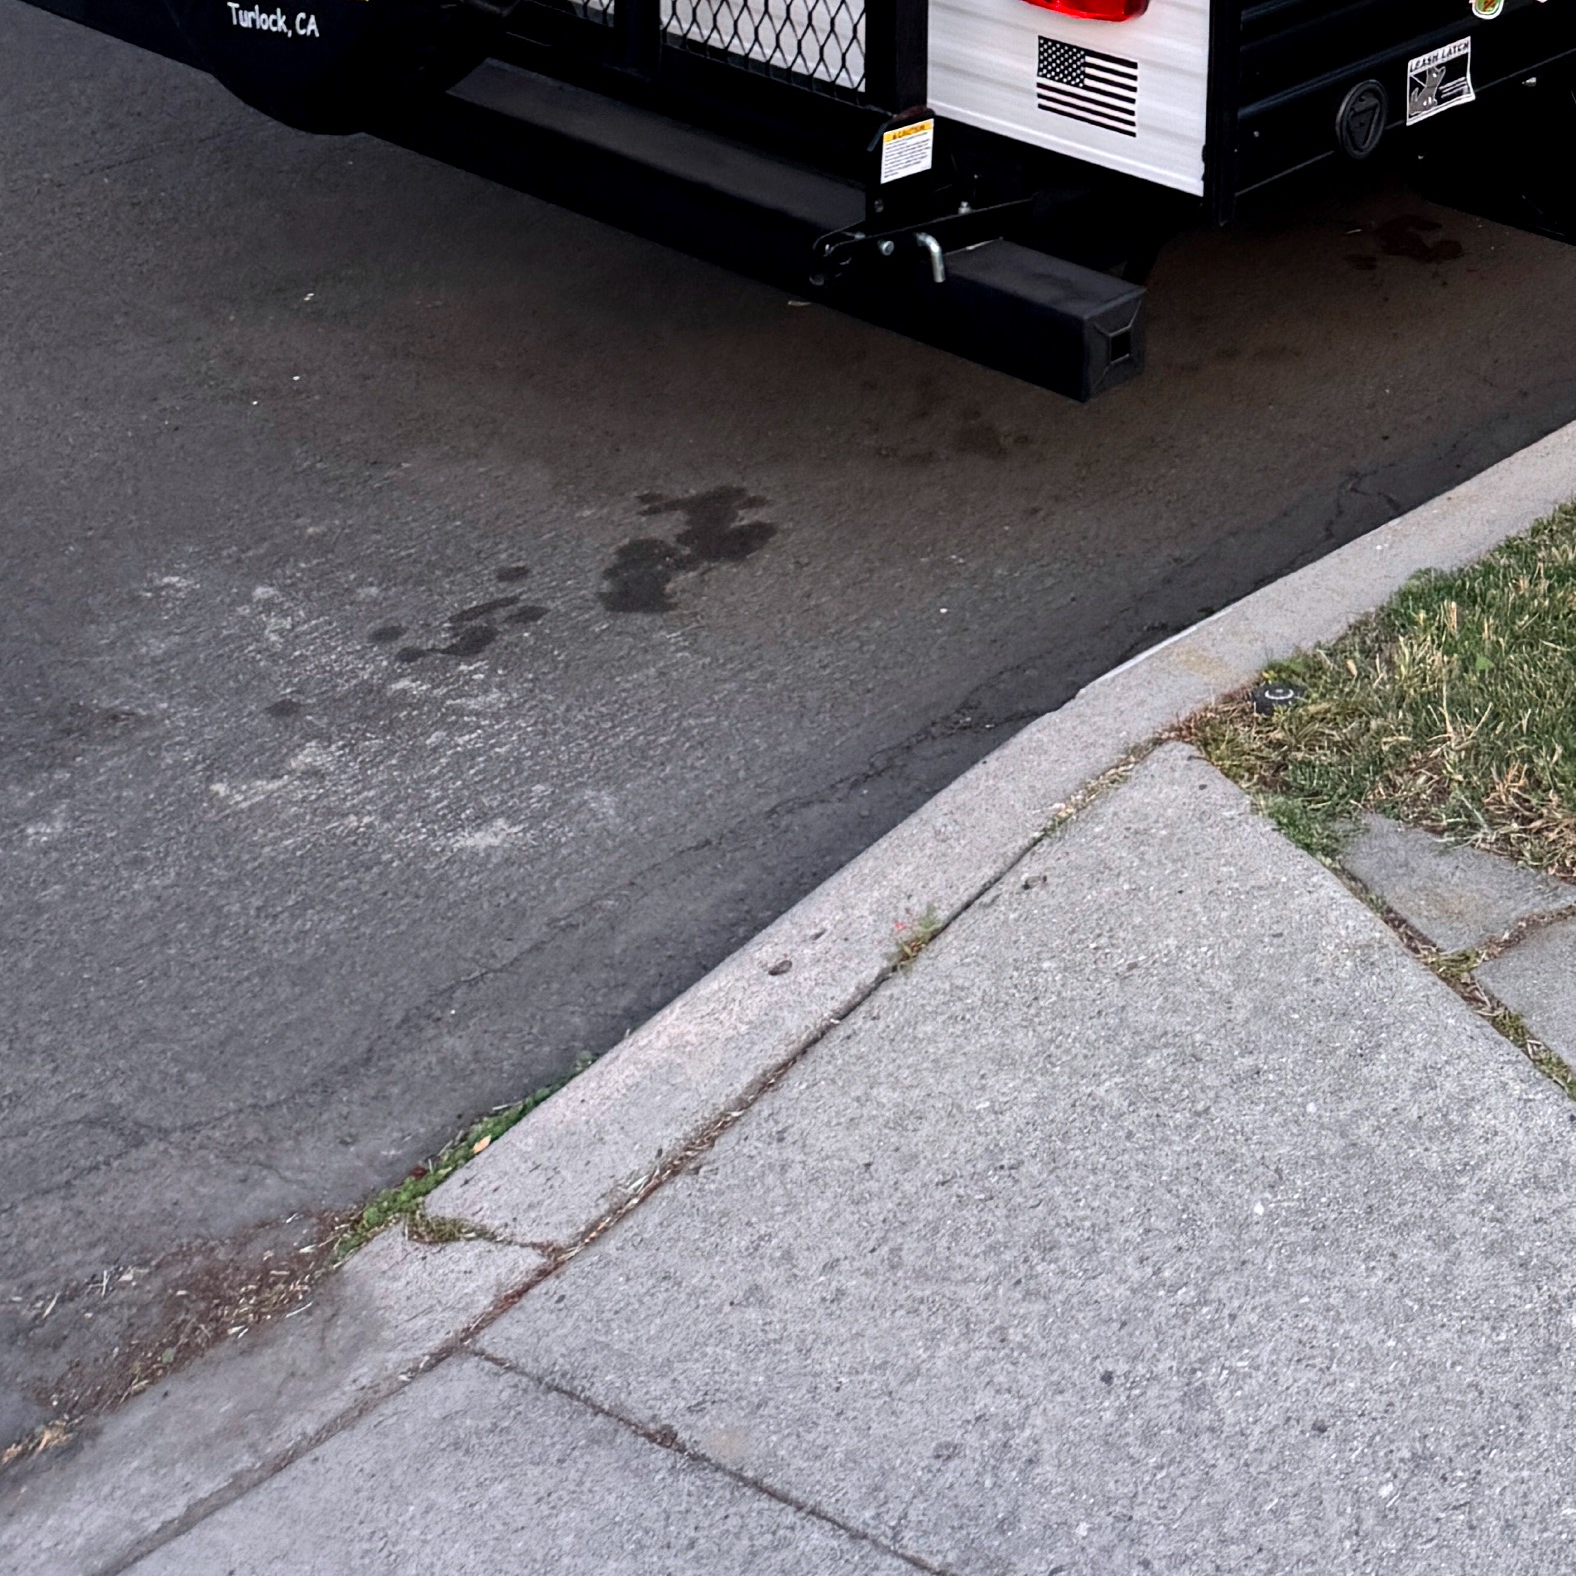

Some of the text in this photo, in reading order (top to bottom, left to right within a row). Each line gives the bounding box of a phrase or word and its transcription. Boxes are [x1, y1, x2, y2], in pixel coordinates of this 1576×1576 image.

[227, 1, 320, 38] Turlock, CA
[1410, 40, 1470, 73] LEASH LATCH
